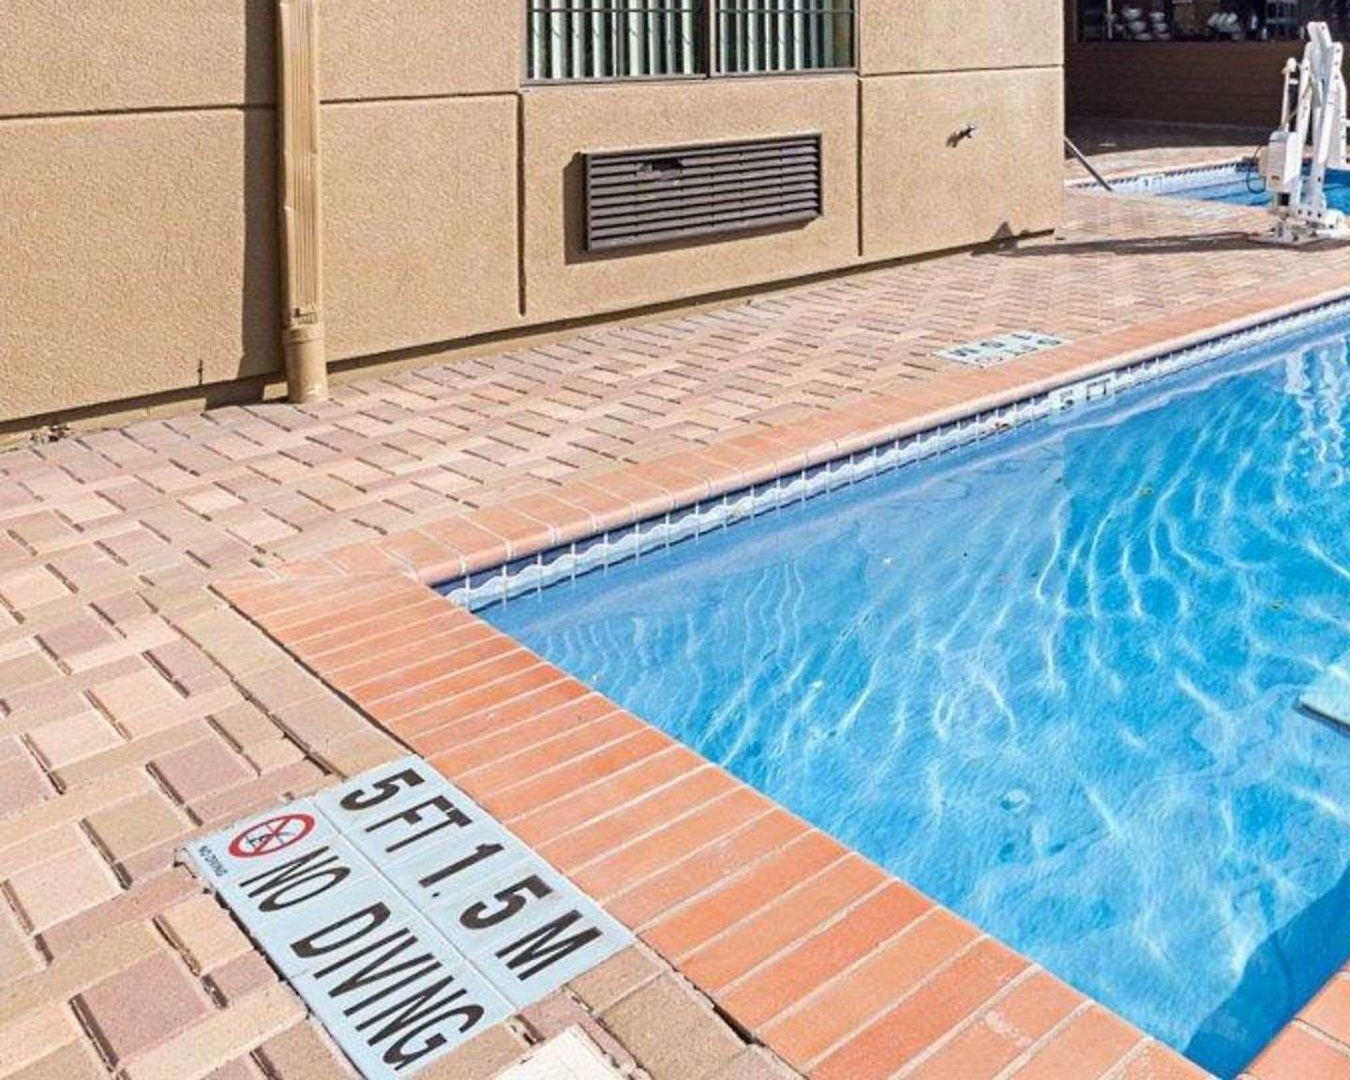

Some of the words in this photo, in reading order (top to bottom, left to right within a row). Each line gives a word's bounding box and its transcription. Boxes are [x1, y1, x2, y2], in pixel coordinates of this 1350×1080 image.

[339, 768, 426, 811] 5
[363, 794, 474, 854] FT
[239, 845, 352, 913] NO
[494, 908, 603, 981] M
[289, 901, 486, 1070] DIVING
